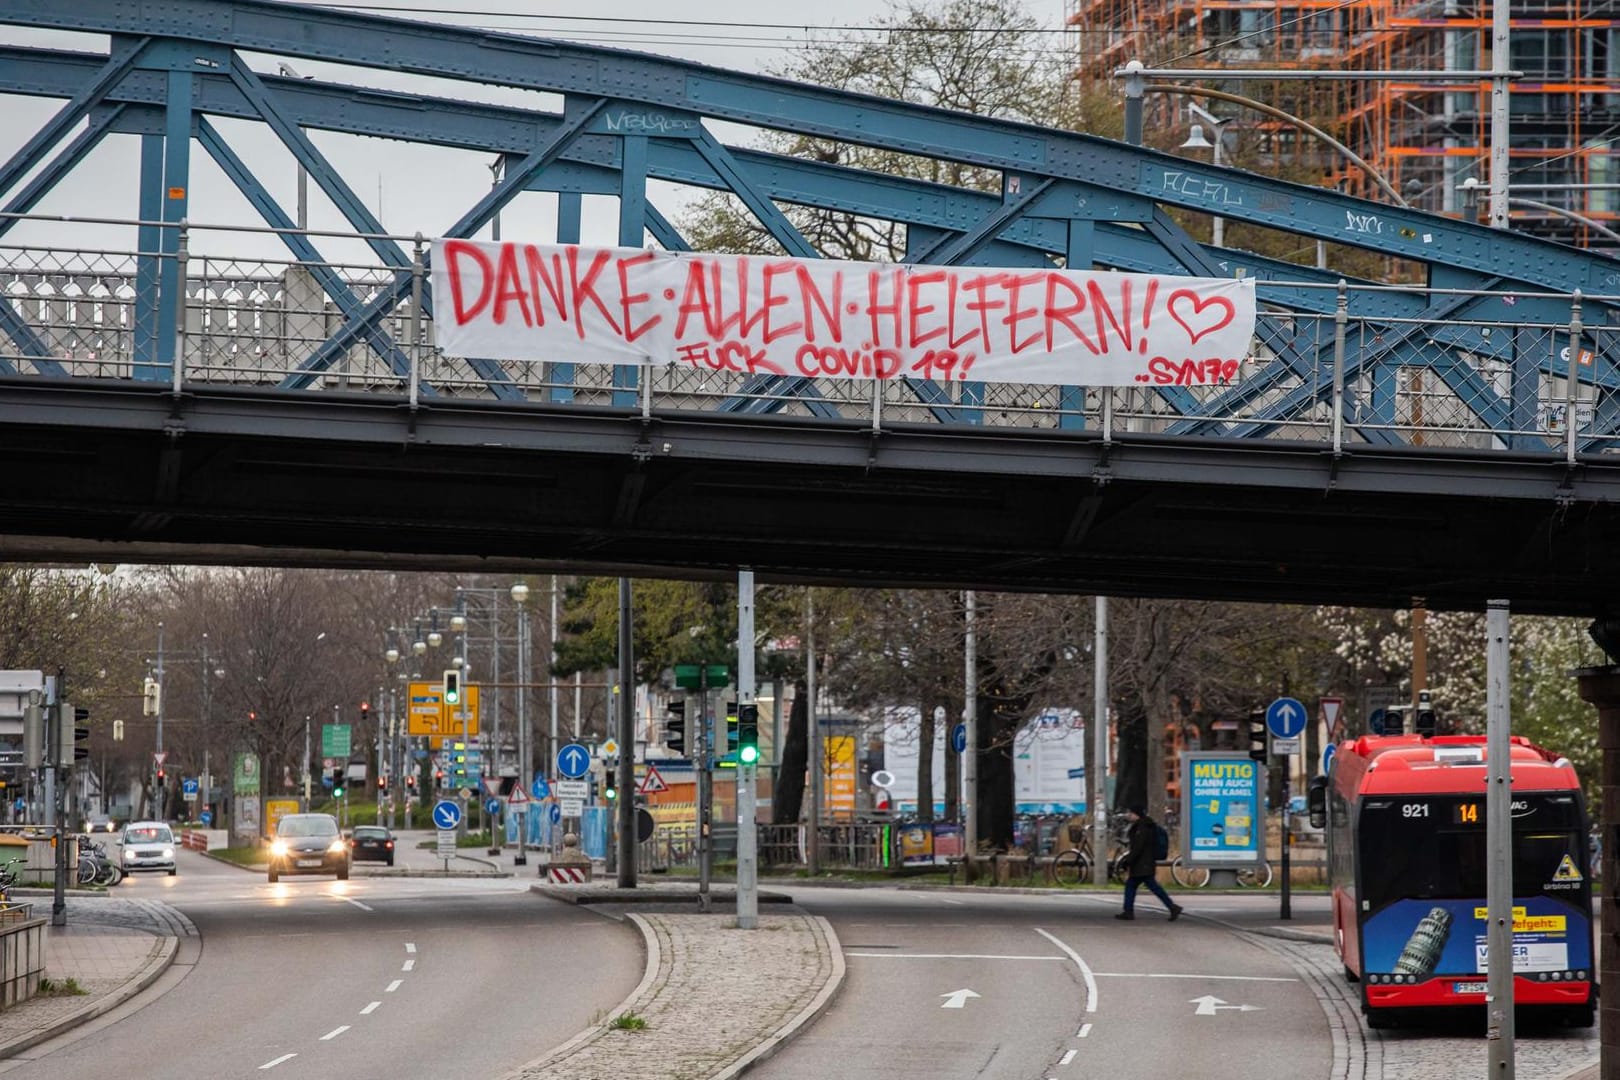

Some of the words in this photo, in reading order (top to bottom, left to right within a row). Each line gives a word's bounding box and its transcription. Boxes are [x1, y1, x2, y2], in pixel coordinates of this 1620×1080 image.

[444, 239, 662, 343] DANKE
[674, 257, 842, 345] ALLEN
[866, 269, 1159, 356] HELFERN!
[676, 340, 785, 376] FUCK
[1194, 764, 1253, 778] MUTIG
[1195, 779, 1223, 787] KANN
[1225, 779, 1253, 787] AUCH
[1194, 788, 1220, 796] OHNE
[1402, 804, 1429, 818] 921
[1460, 804, 1478, 823] 14
